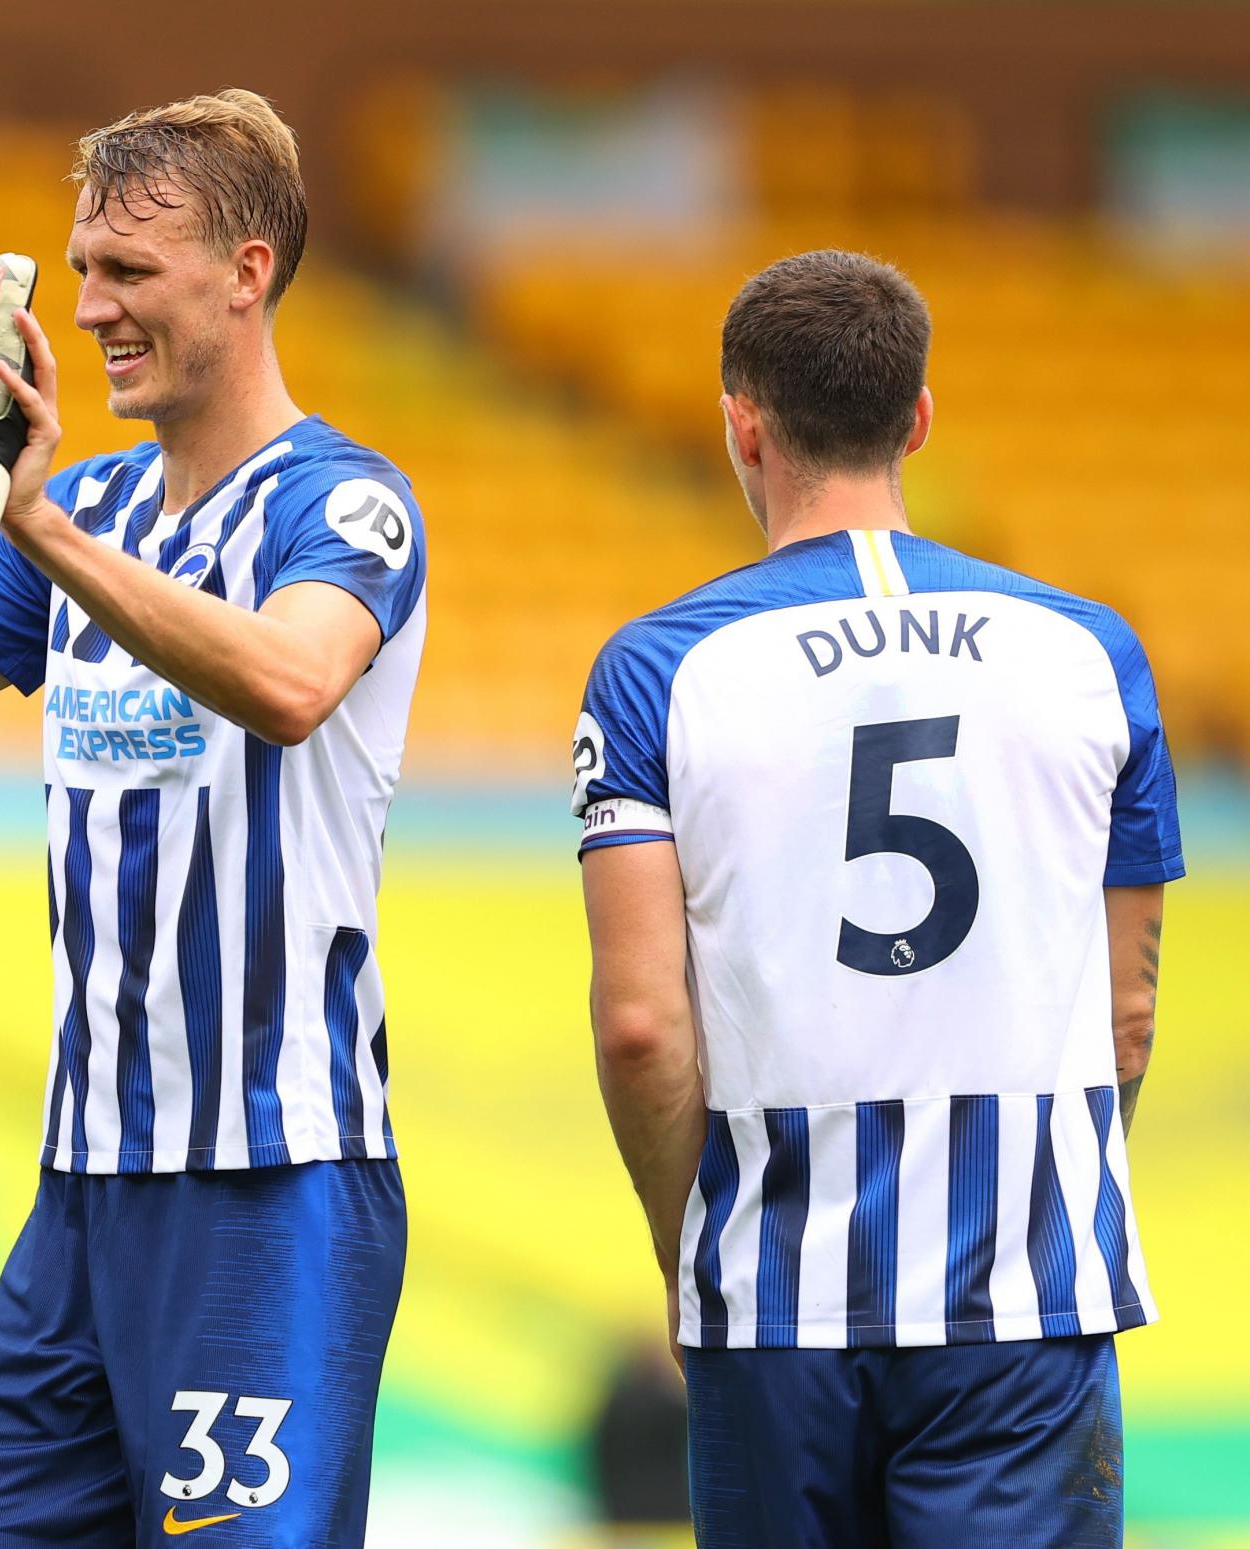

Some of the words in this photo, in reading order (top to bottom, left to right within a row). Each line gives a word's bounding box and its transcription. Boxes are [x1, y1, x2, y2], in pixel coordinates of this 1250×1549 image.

[339, 495, 405, 550] JD
[796, 610, 990, 678] DUNK
[45, 684, 194, 723] AMERICAN
[56, 723, 206, 761] EXPRESS
[836, 714, 980, 977] 5
[160, 1390, 294, 1508] 33
